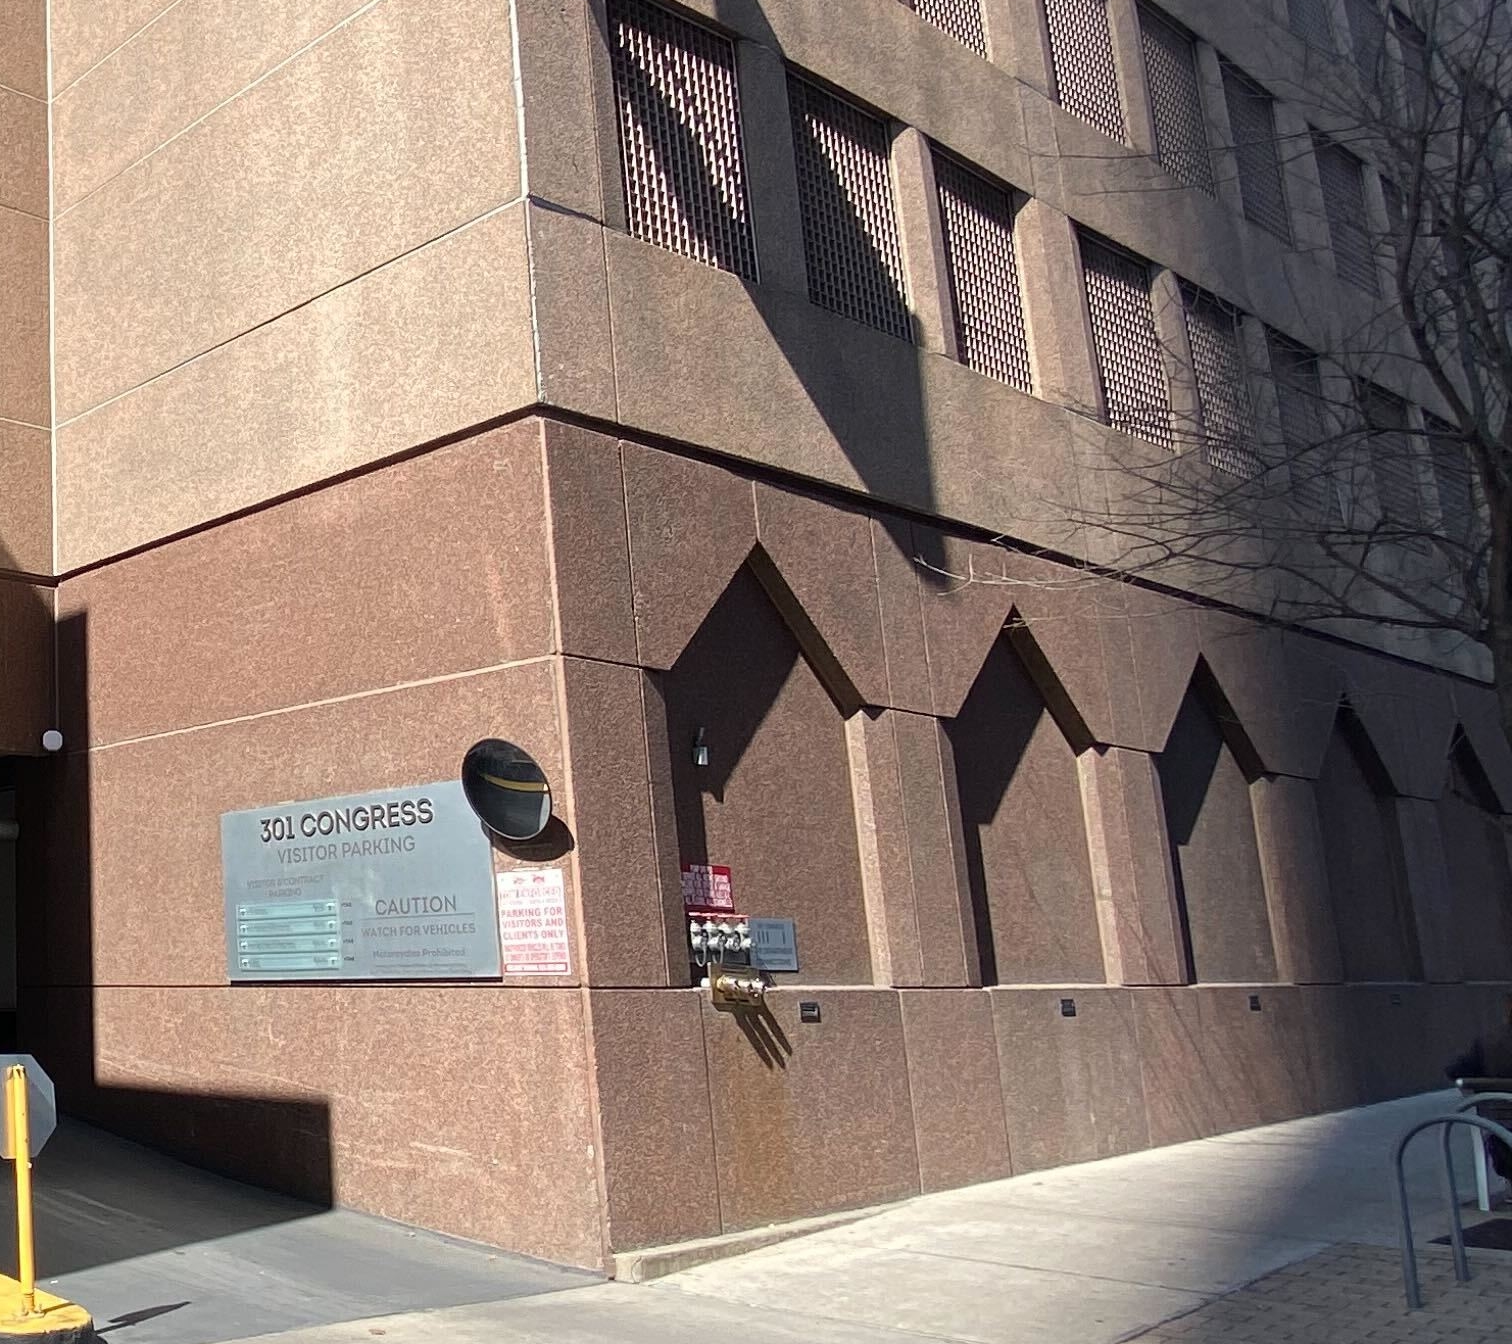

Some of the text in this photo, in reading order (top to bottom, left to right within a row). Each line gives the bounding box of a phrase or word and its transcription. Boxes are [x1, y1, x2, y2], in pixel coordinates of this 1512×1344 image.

[260, 798, 434, 843] 301 CONGRESS
[277, 835, 416, 864] VISITOR PARKING
[375, 895, 457, 916] CAUTION
[501, 906, 562, 918] PARKING FOR
[361, 922, 476, 937] WATCH FOR VEHICLES
[502, 917, 563, 928] VISITORS AND
[503, 929, 564, 940] CLIENTS ONLY
